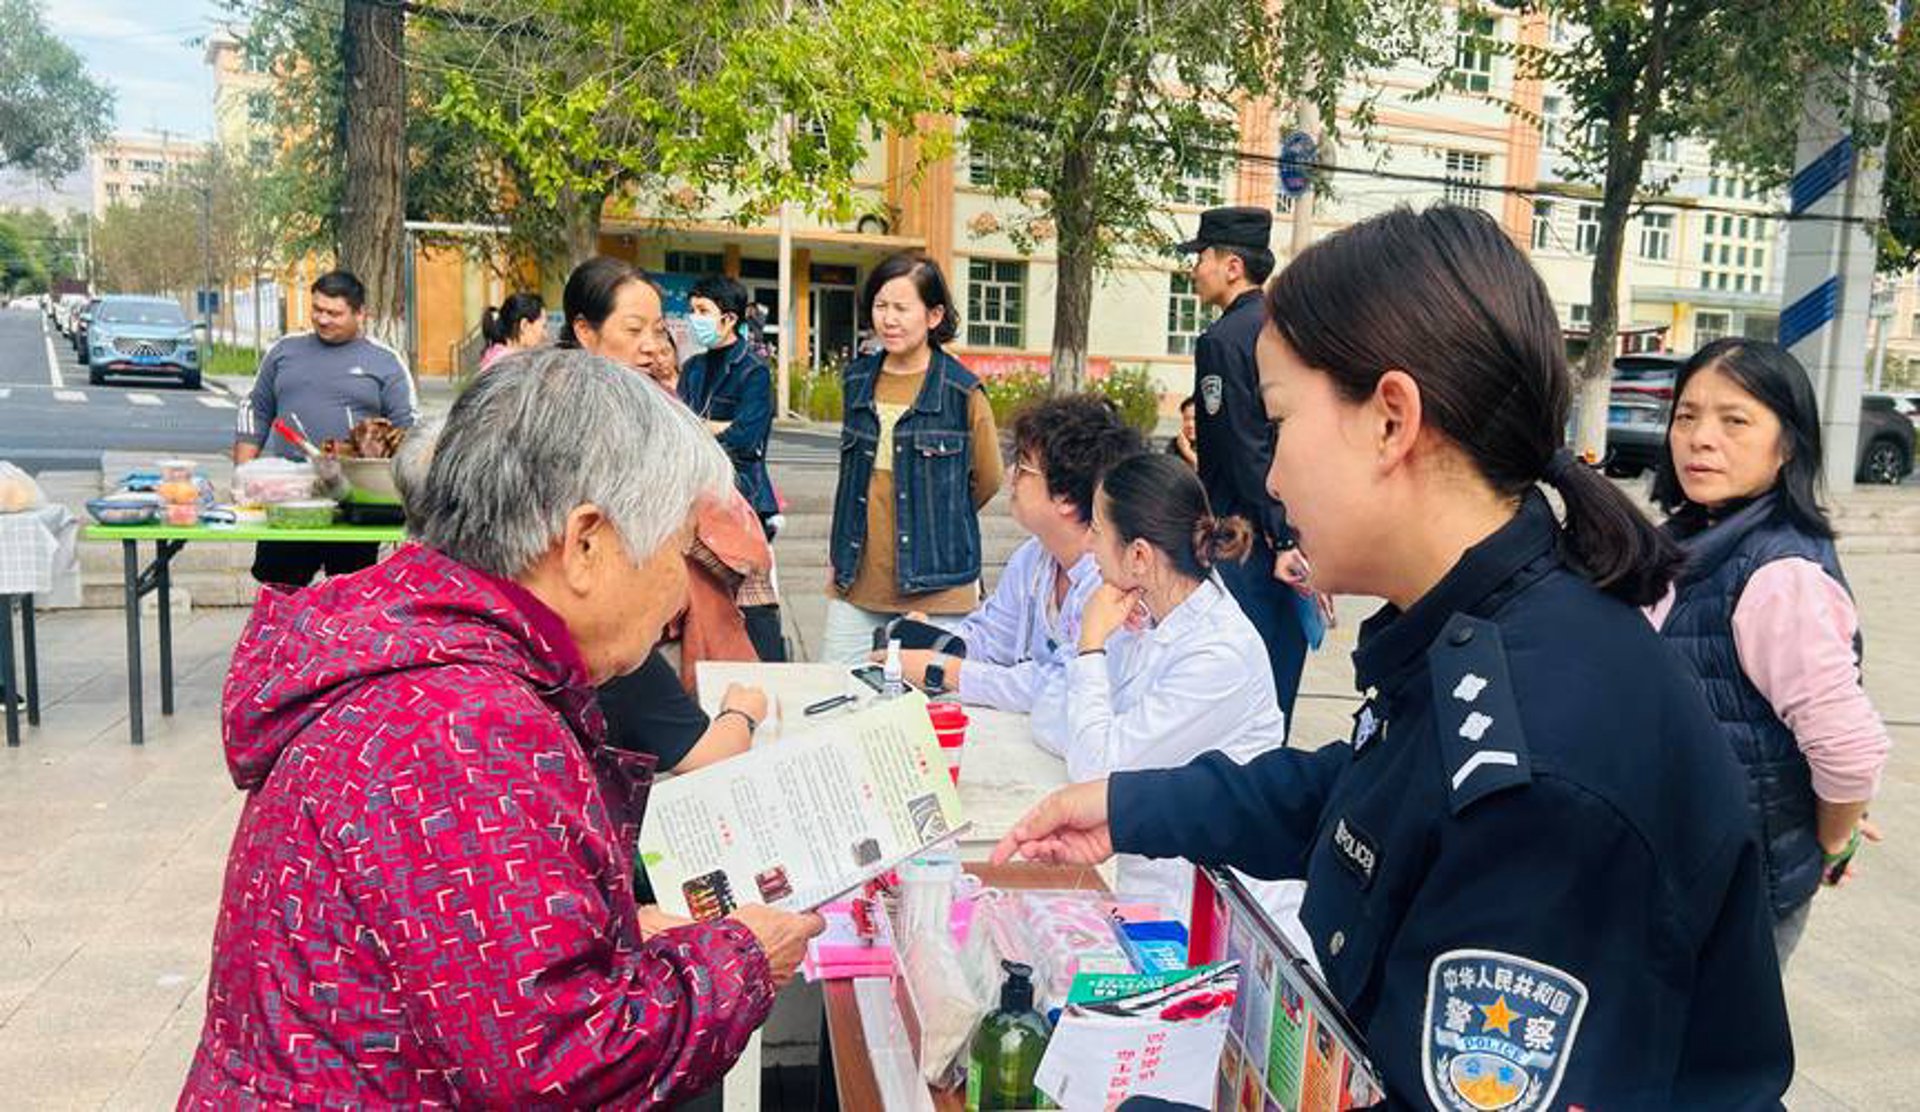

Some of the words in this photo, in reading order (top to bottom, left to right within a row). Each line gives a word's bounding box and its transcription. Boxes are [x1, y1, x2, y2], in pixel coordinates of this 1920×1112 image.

[1443, 965, 1571, 1015] 中华人民共和国
[1523, 1016, 1556, 1050] 察
